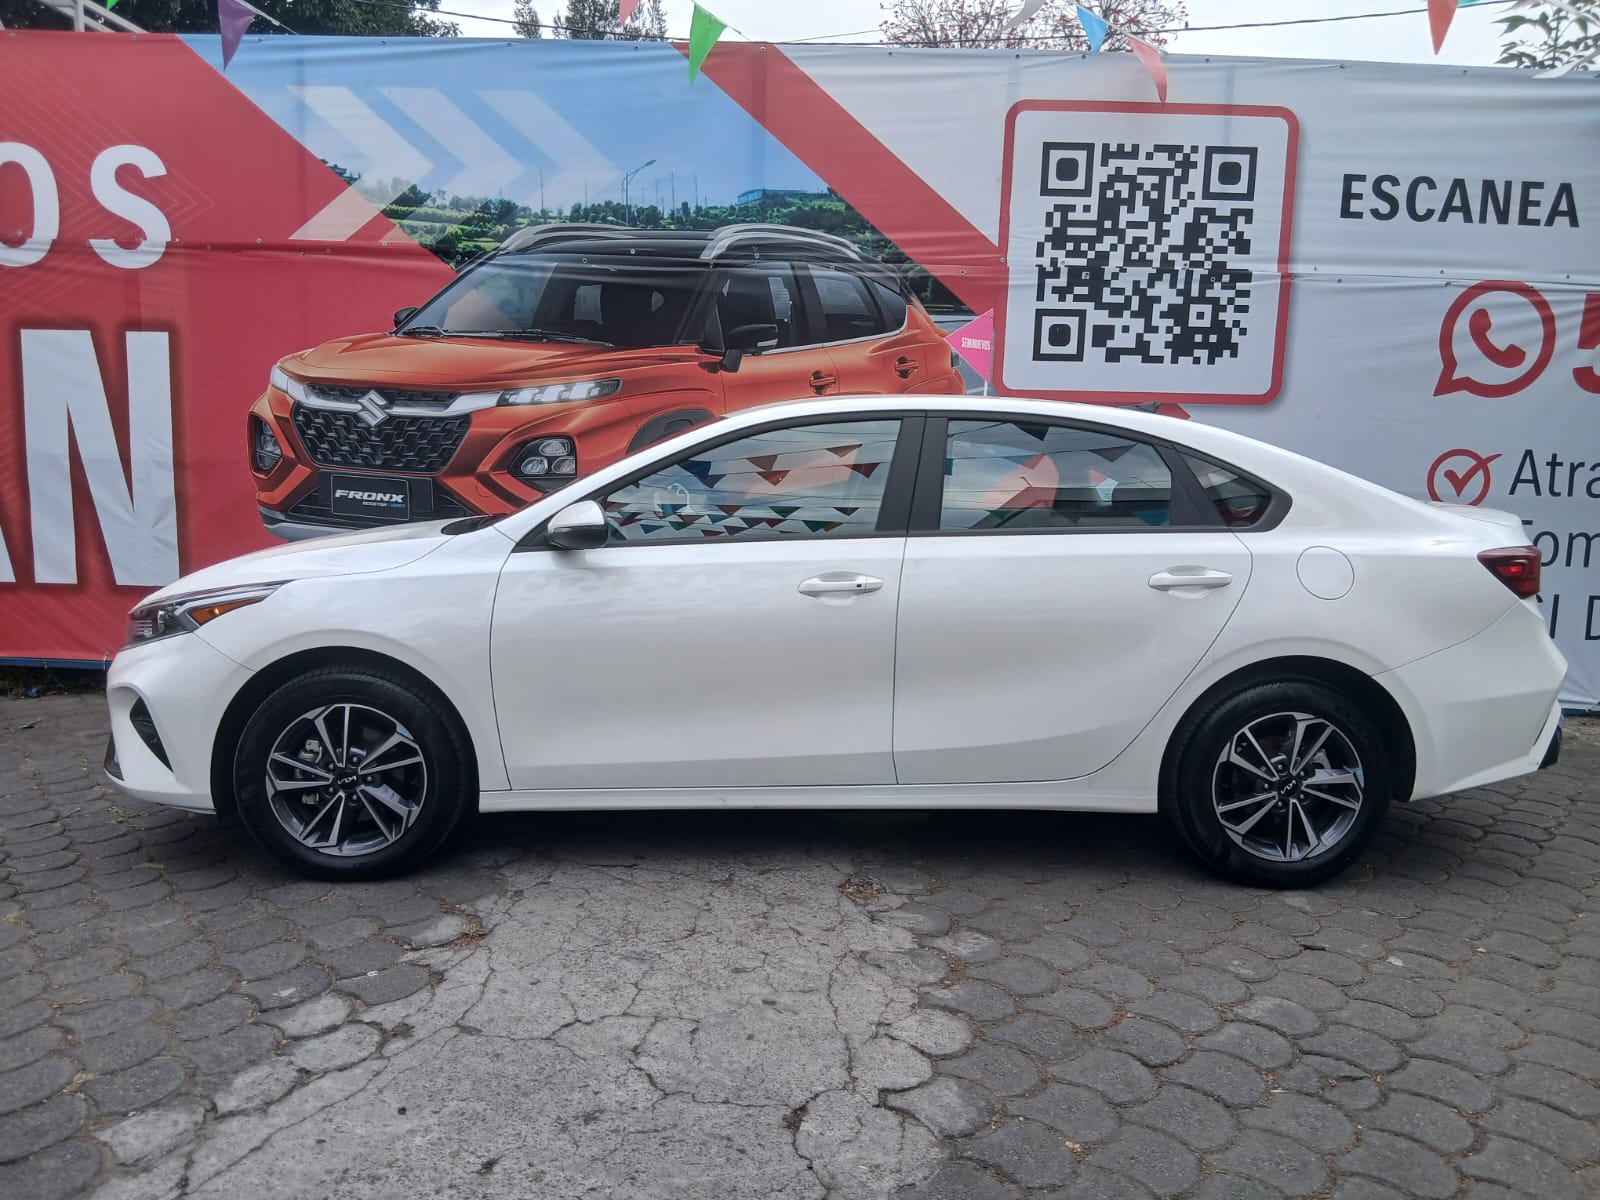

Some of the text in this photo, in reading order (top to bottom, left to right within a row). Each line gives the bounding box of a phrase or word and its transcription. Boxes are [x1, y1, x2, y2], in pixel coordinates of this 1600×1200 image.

[1340, 173, 1580, 229] ESCANEA
[0, 328, 181, 587] N
[334, 489, 406, 503] FRONX
